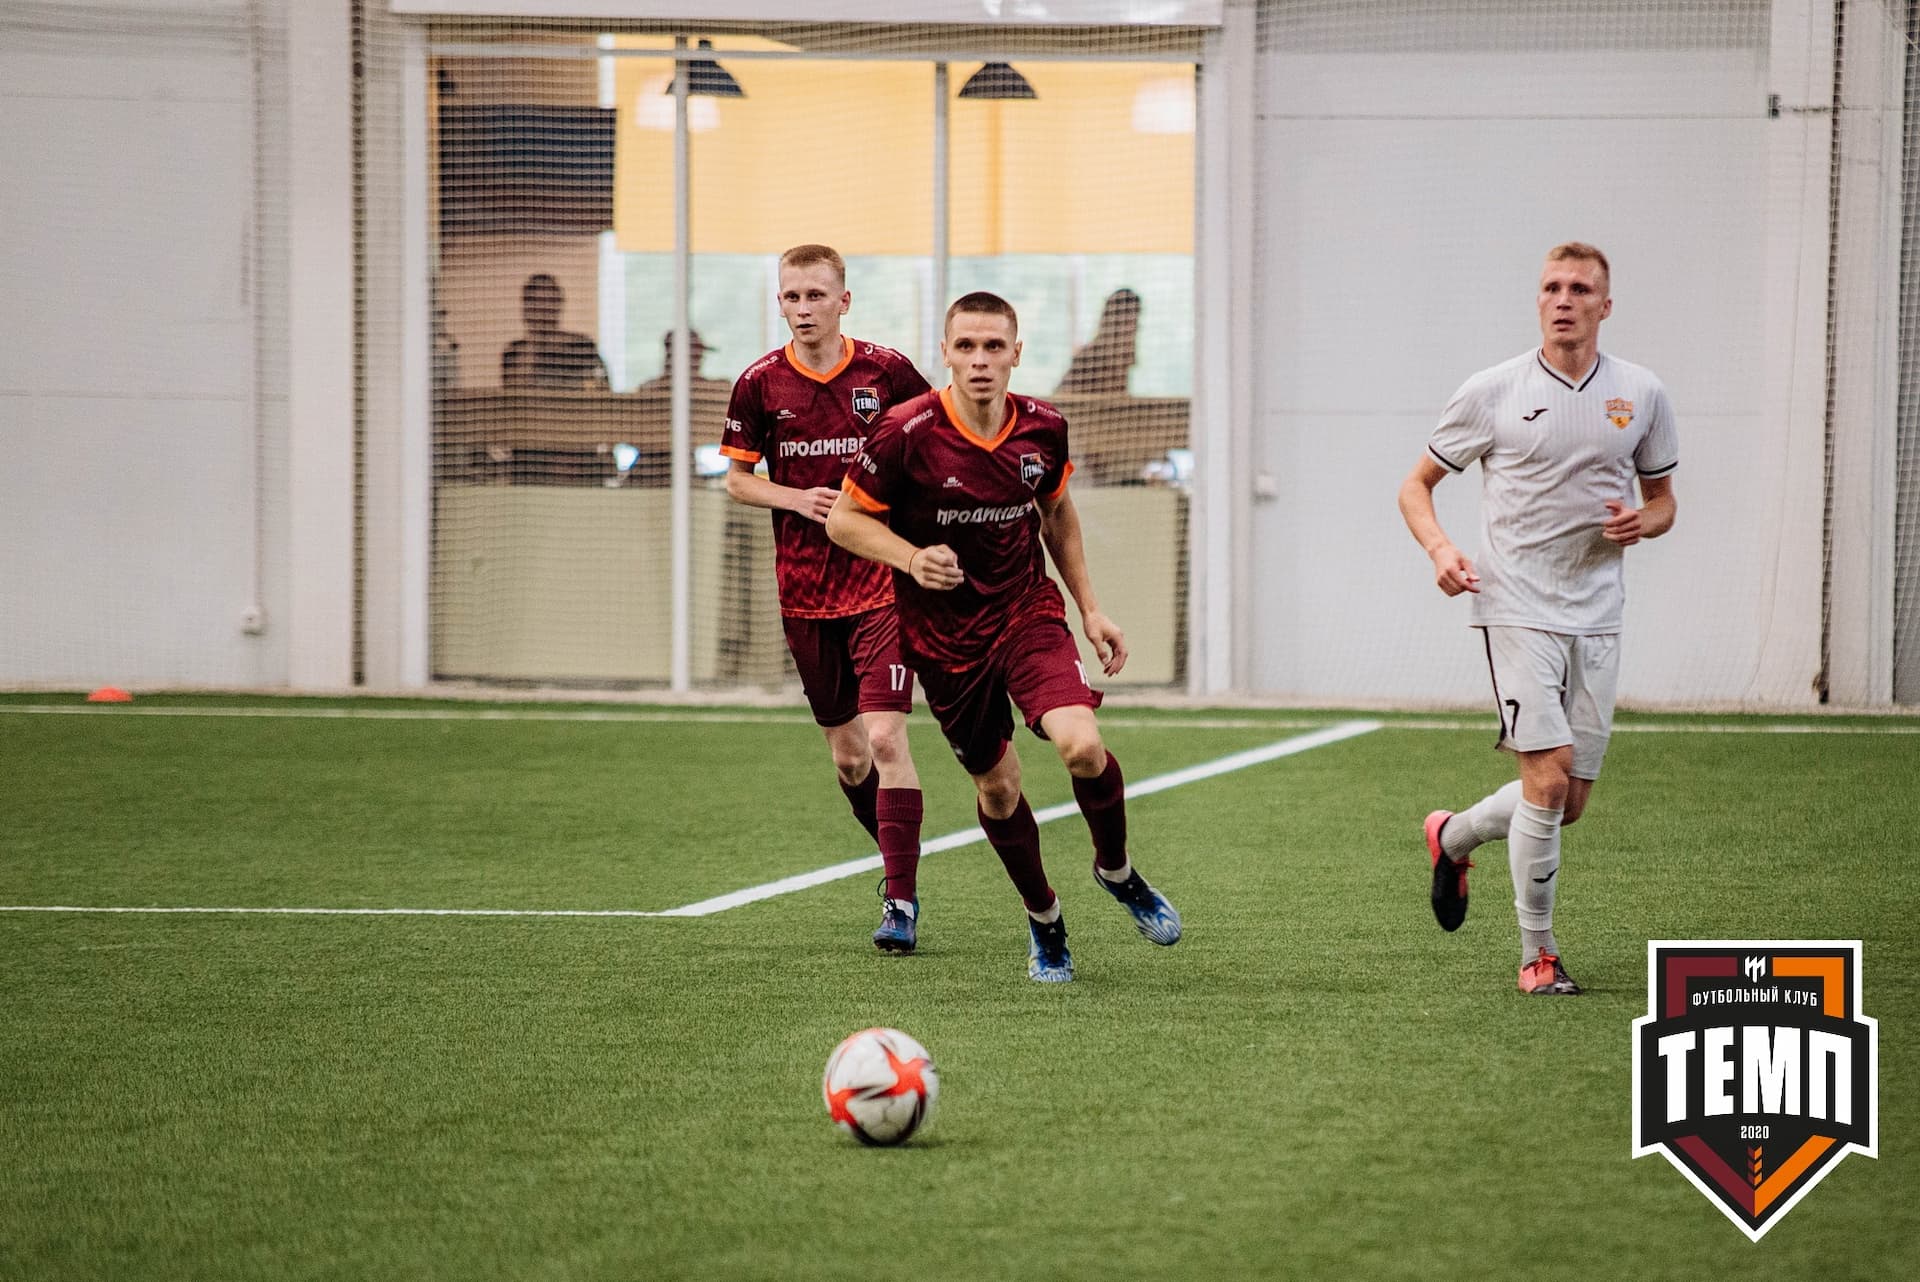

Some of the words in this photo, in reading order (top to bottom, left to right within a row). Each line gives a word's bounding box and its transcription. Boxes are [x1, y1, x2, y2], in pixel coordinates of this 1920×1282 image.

[855, 397, 878, 411] ТЕМП
[889, 664, 907, 691] 17
[1074, 660, 1090, 688] 1
[1504, 699, 1520, 739] 7
